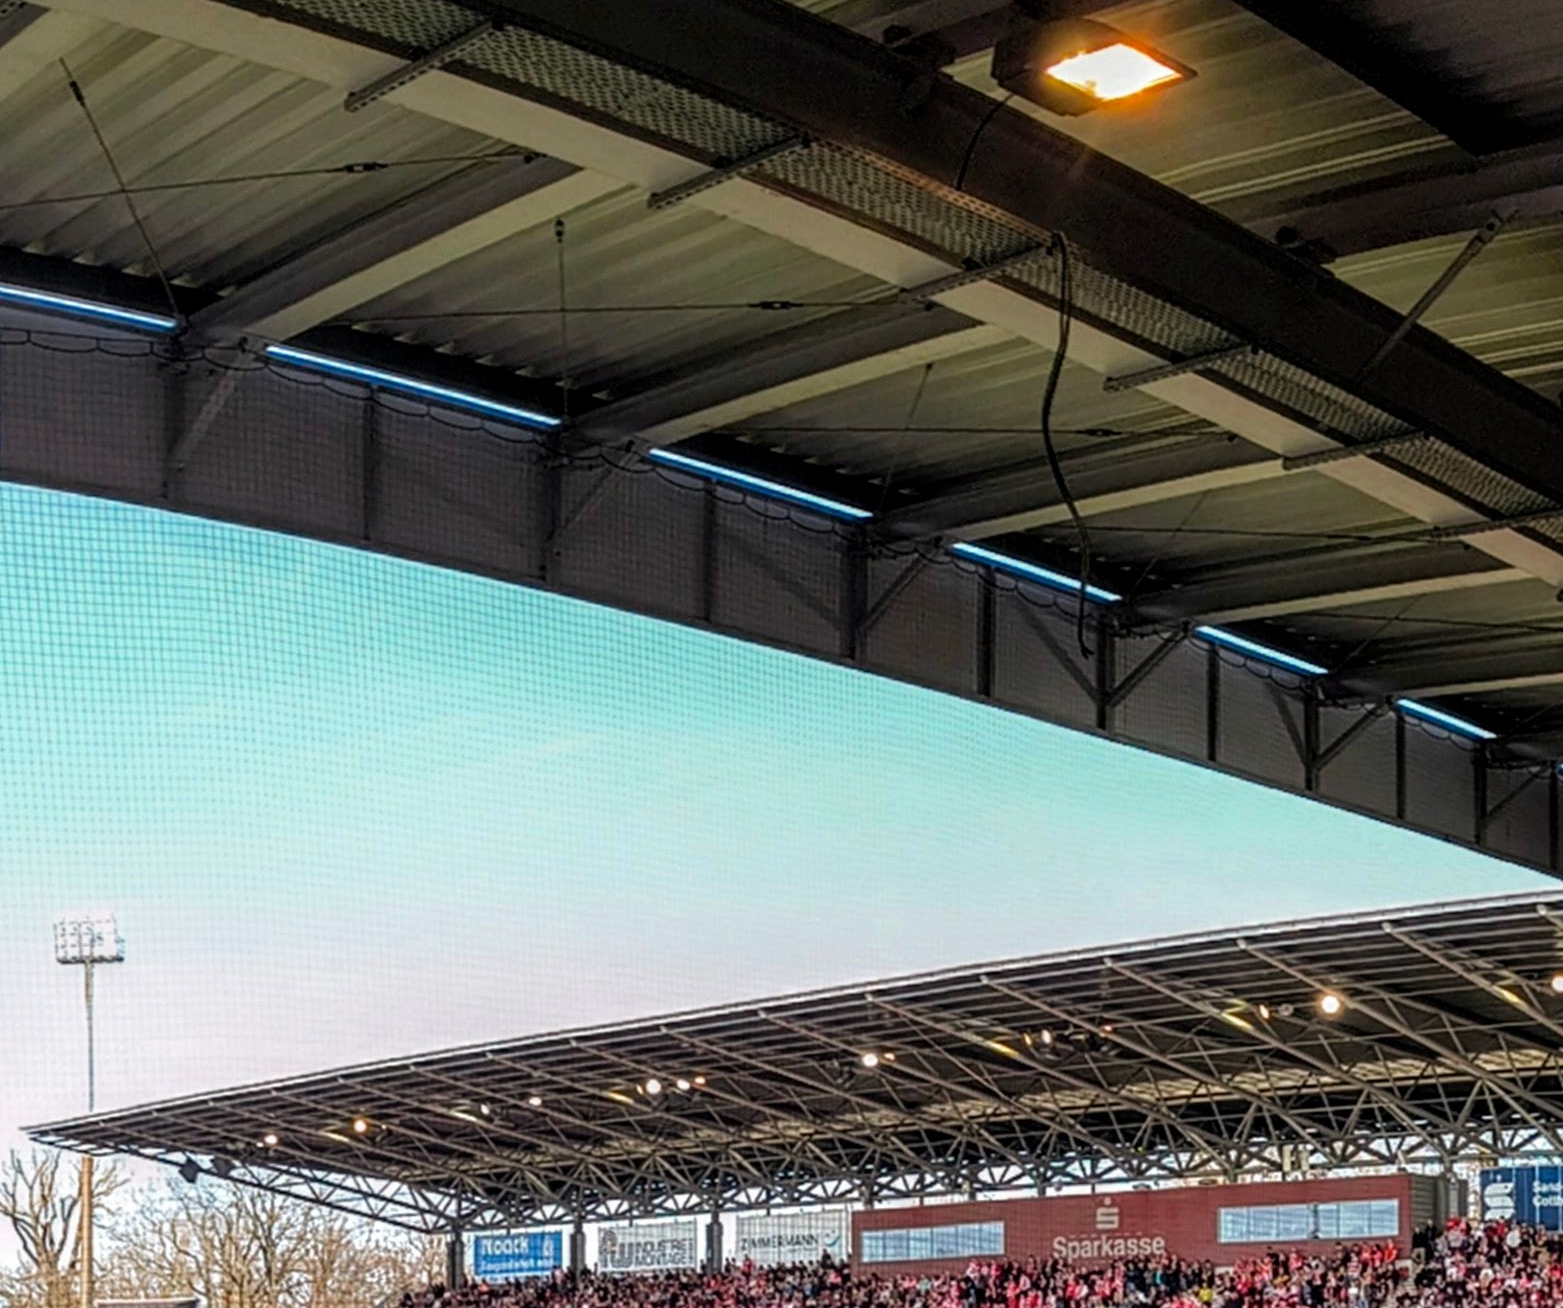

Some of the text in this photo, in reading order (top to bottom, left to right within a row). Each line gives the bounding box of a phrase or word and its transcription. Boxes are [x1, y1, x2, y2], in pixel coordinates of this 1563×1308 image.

[481, 1238, 529, 1255] Noack
[739, 1233, 818, 1250] ZIMMERMANN
[1053, 1236, 1165, 1263] Sparkasse
